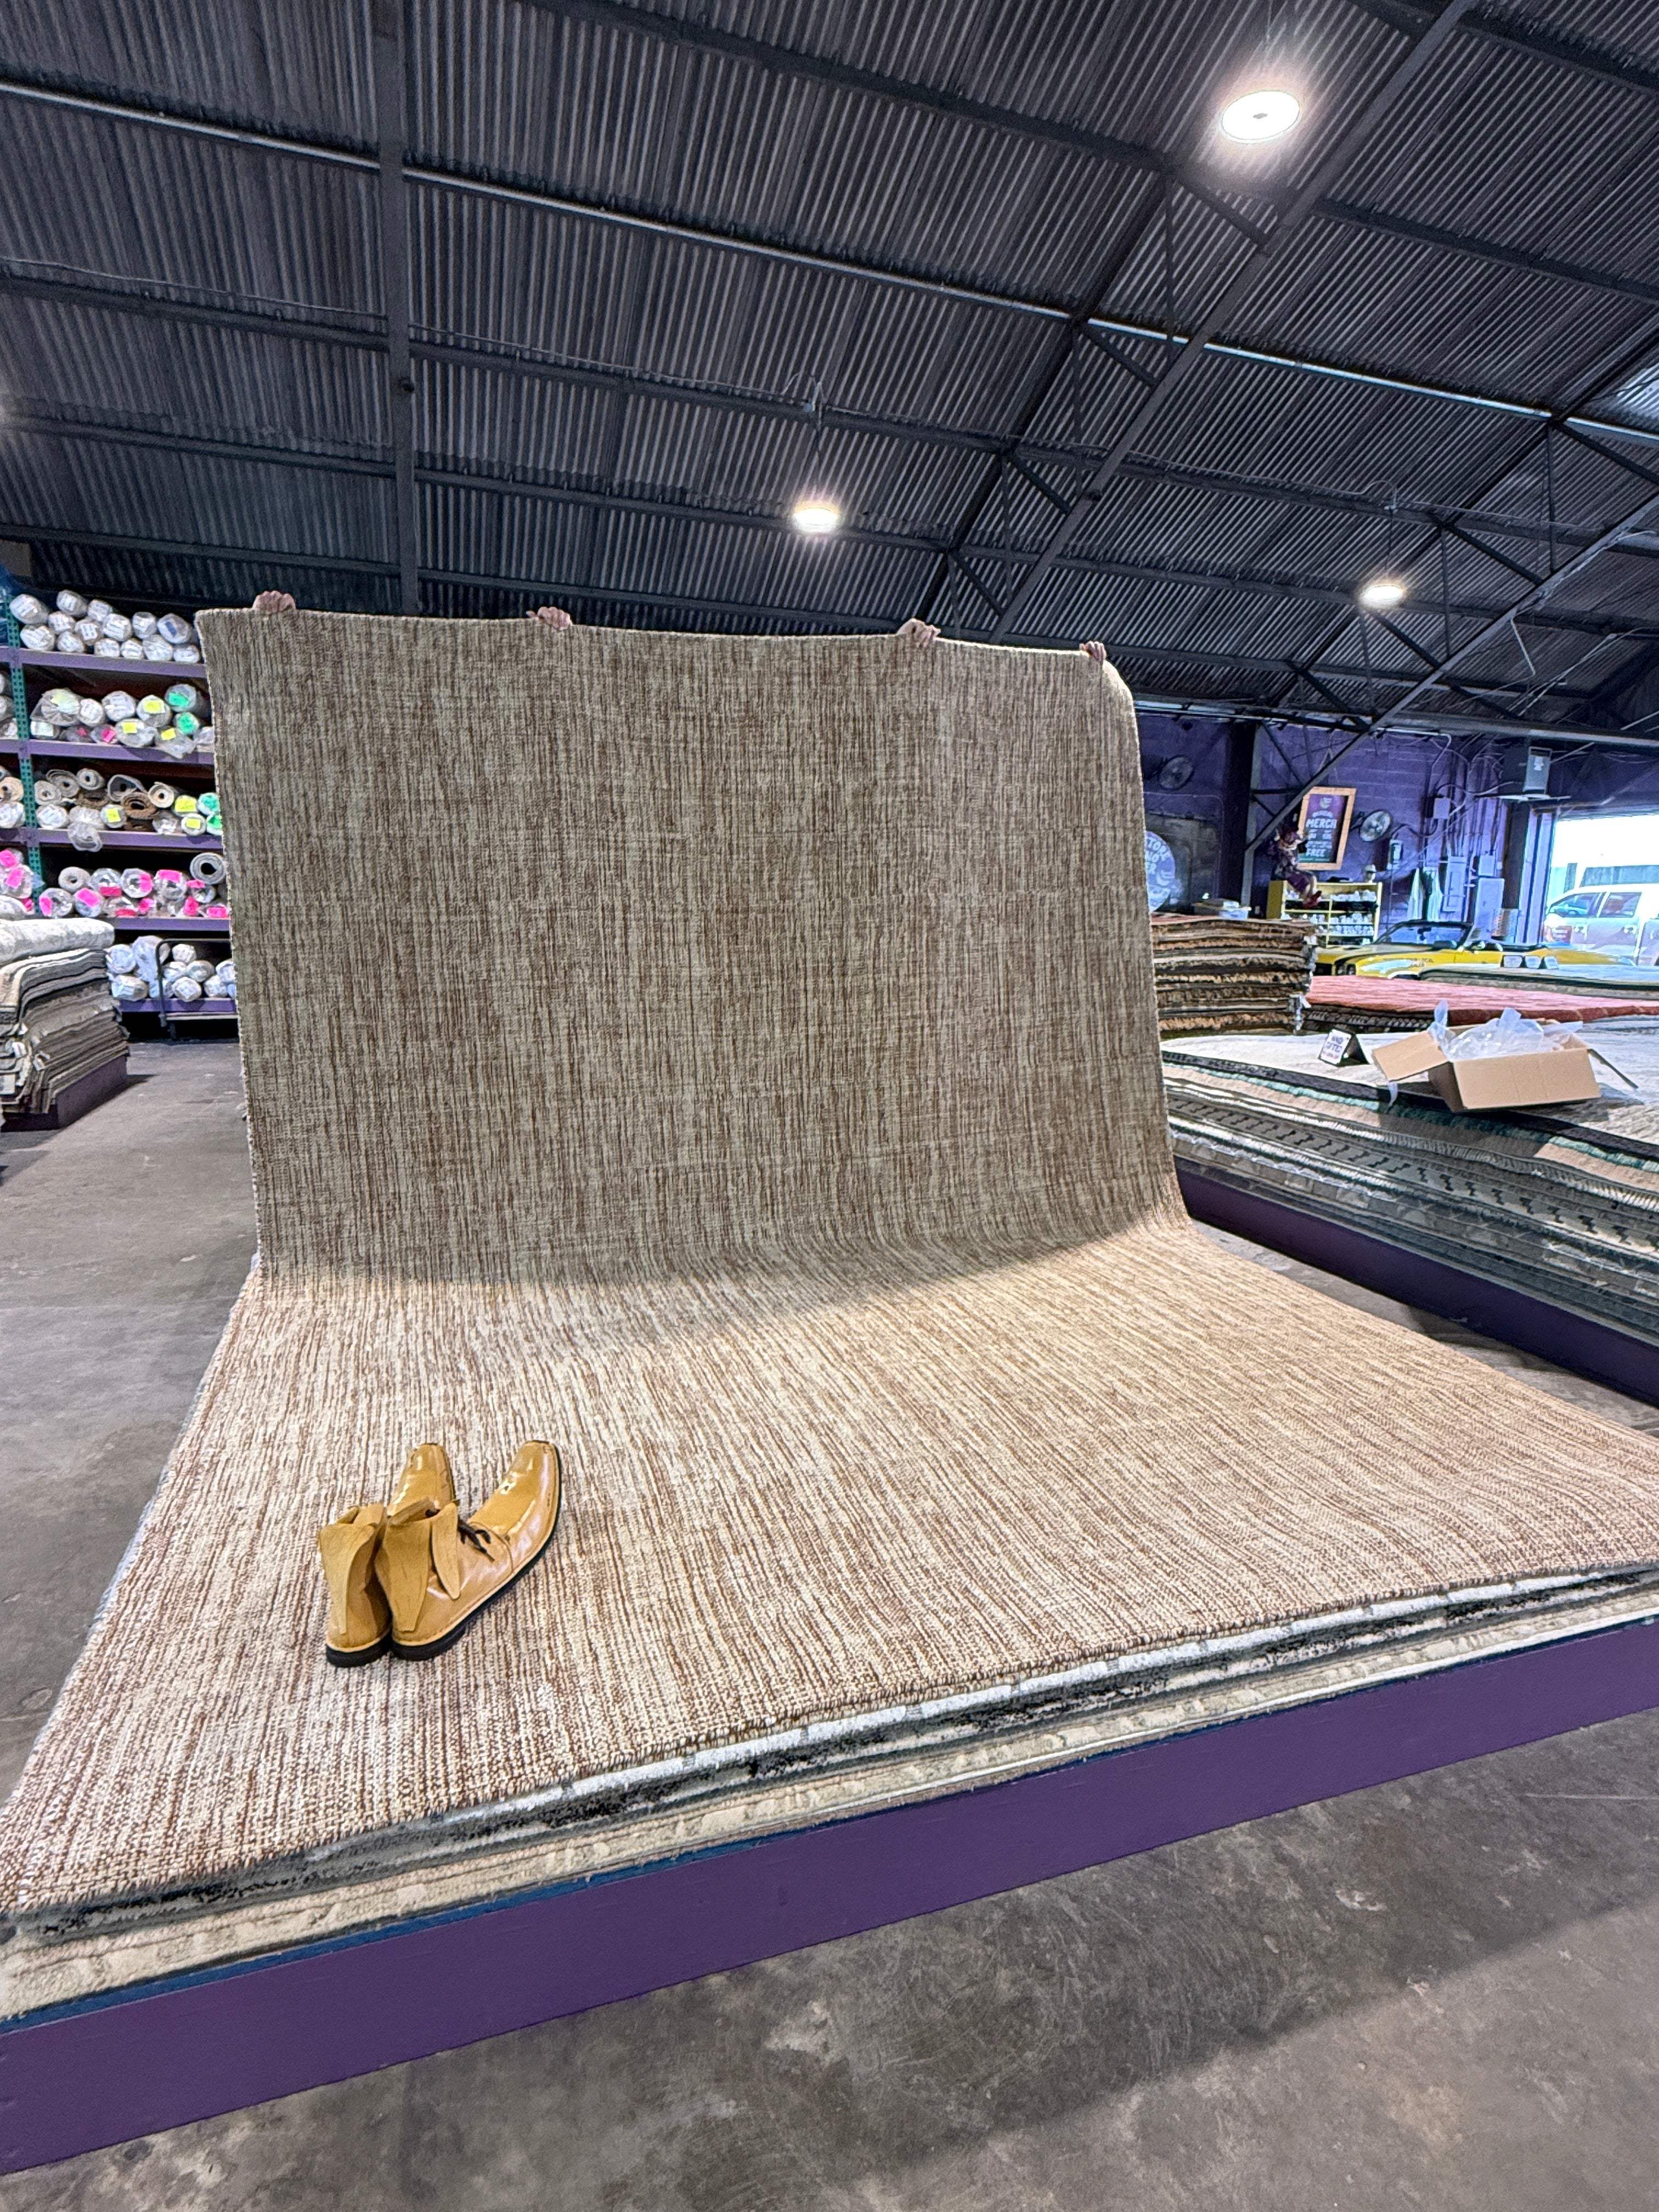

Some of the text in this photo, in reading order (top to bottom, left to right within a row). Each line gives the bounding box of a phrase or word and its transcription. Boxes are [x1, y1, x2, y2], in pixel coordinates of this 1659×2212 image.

[1306, 819, 1337, 828] MERCH
[1146, 837, 1171, 861] TORE
[1306, 849, 1326, 857] FREE
